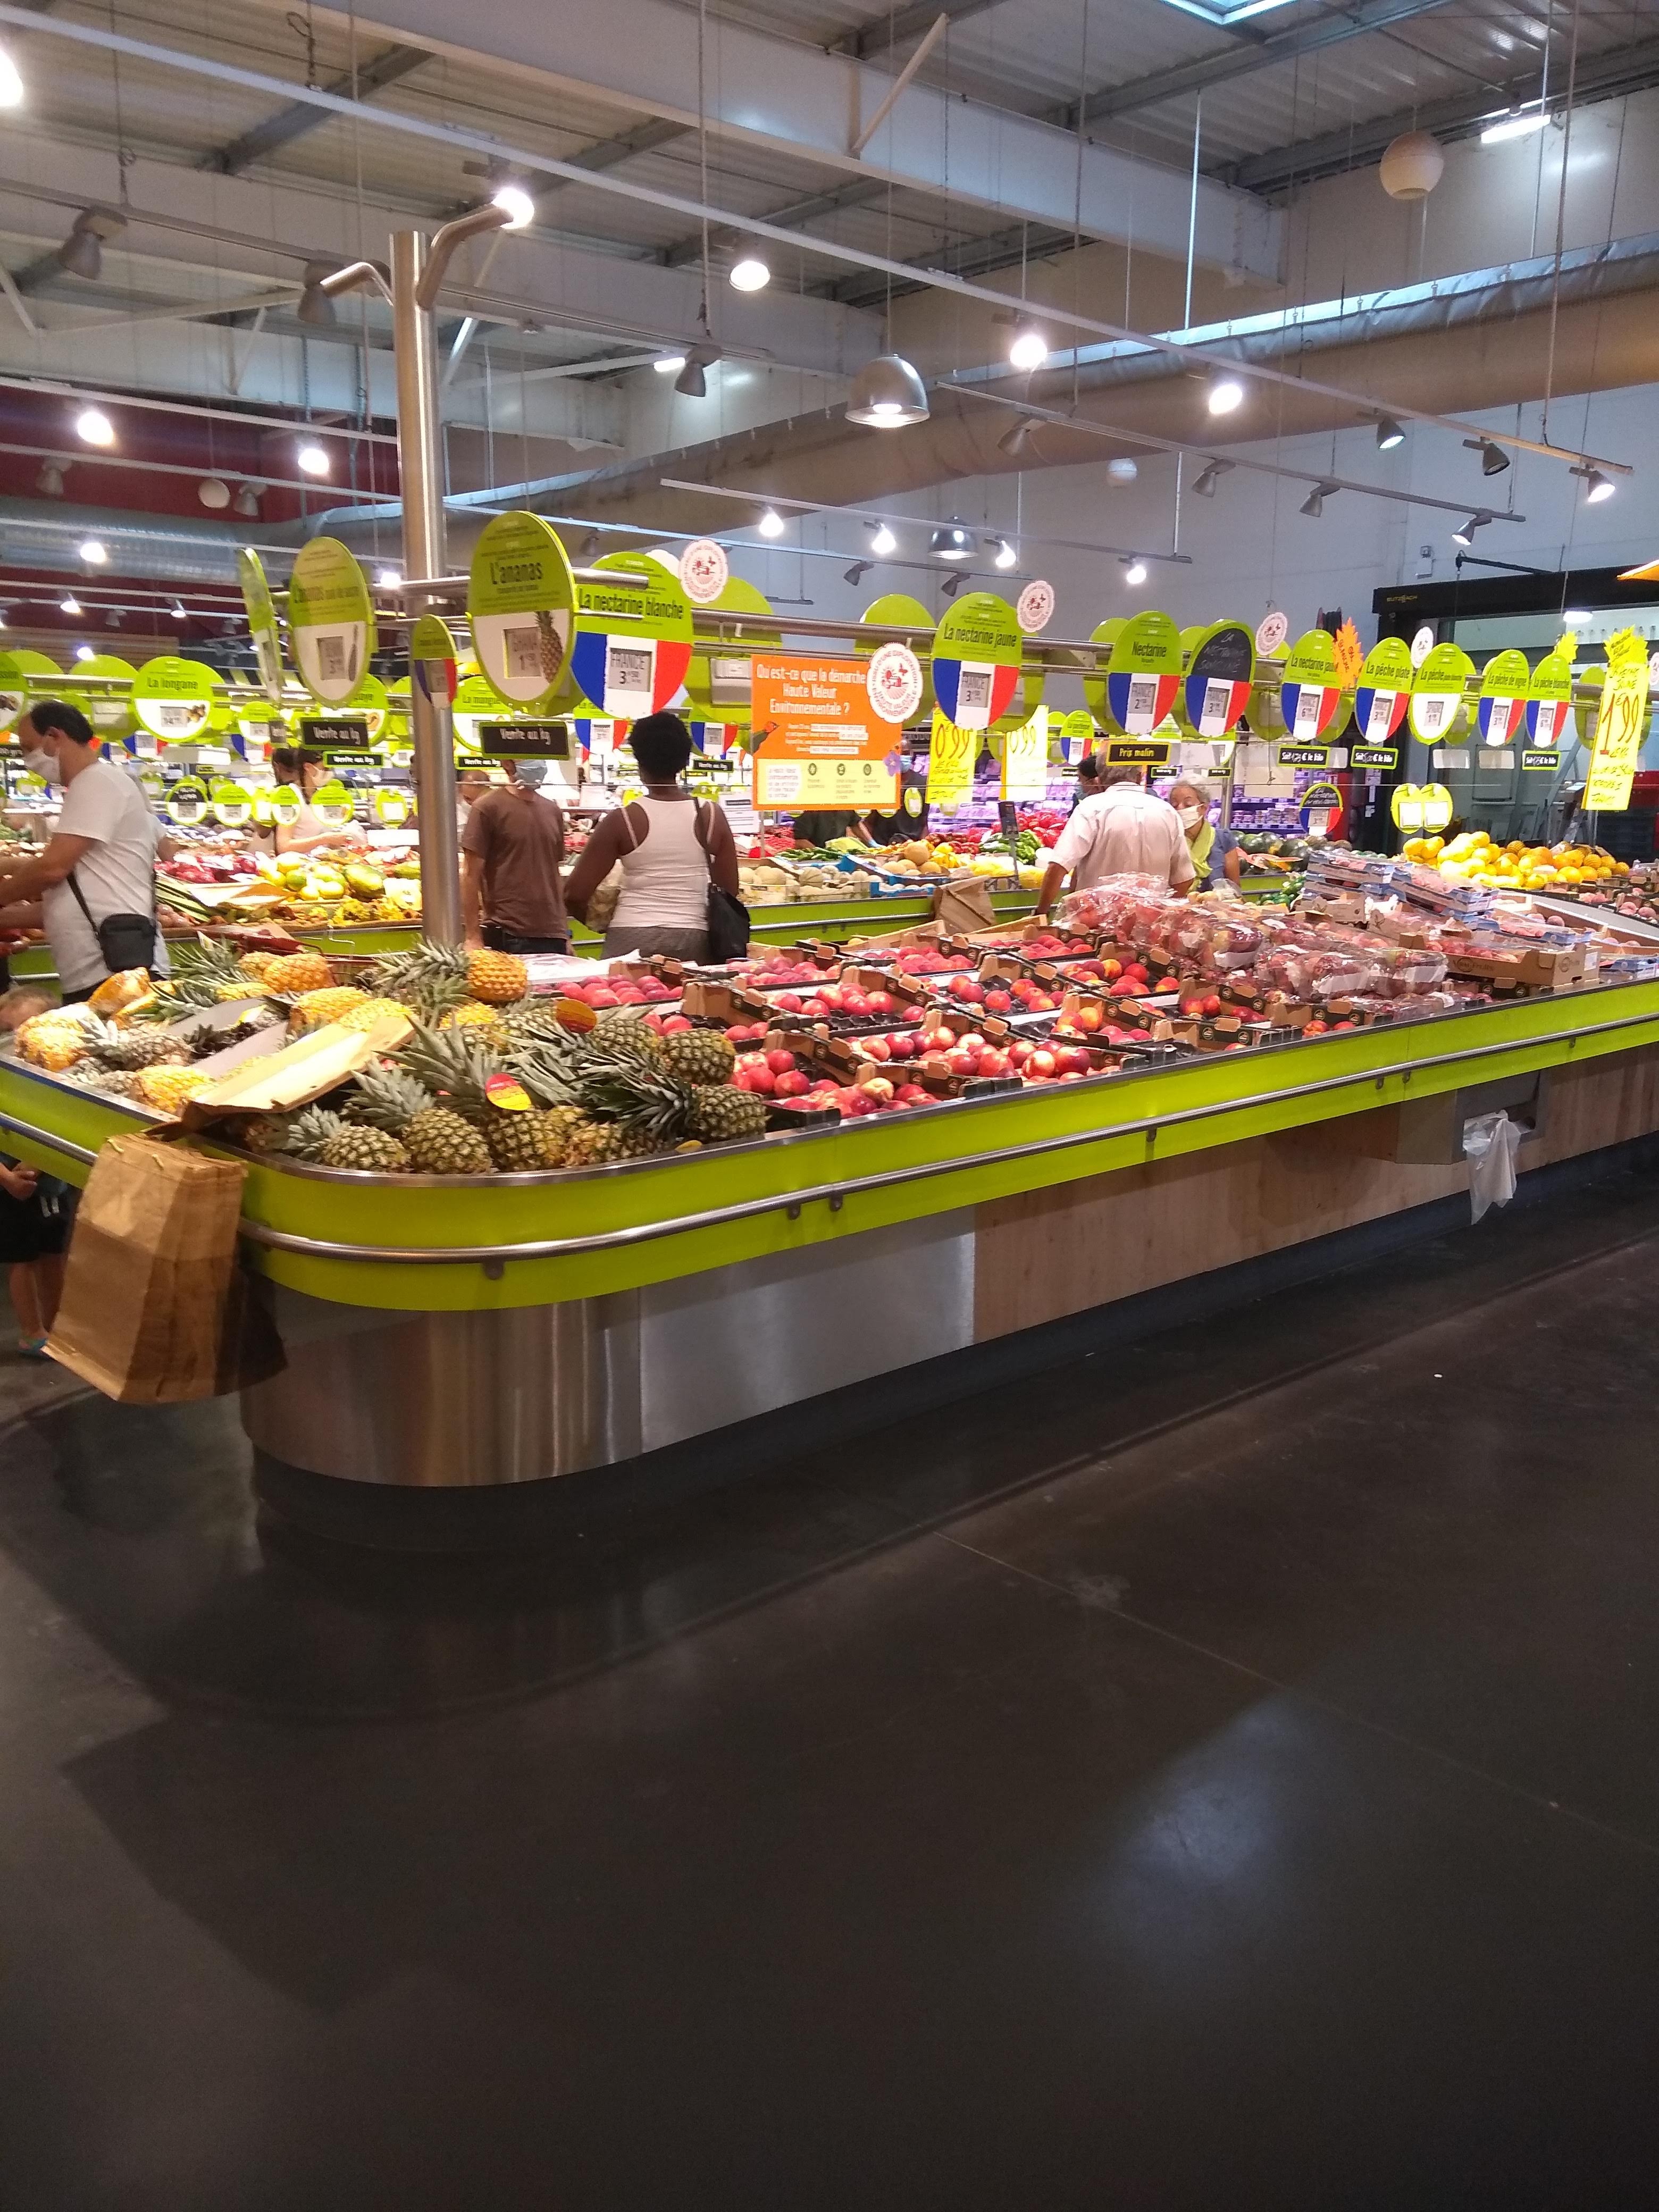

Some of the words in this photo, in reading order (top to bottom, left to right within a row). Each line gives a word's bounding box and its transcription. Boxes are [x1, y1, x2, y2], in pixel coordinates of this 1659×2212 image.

[490, 562, 543, 584] L'ananas
[579, 588, 591, 609] La
[593, 594, 643, 615] nectarine
[646, 596, 684, 620] blanche
[943, 623, 954, 640] La
[955, 627, 994, 646] nectarine
[994, 630, 1017, 648] jaune
[1132, 641, 1167, 658] Nectarine
[1291, 655, 1297, 667] La
[1298, 657, 1323, 671] nectarine
[1366, 661, 1373, 674] La
[1395, 665, 1410, 679] plate
[147, 677, 158, 688] La
[801, 669, 818, 683] que
[819, 667, 827, 682] la
[828, 668, 866, 684] démarche
[1420, 668, 1427, 680] La
[1489, 673, 1495, 684] La
[463, 694, 472, 703] La
[783, 683, 810, 698] Haute
[811, 684, 837, 699] Valeur
[769, 698, 842, 715] Environnementale
[843, 702, 850, 715] ?
[313, 726, 339, 739] Vente
[339, 730, 350, 740] au
[349, 726, 361, 745] kg
[500, 728, 525, 740] Vente
[527, 731, 539, 740] au
[539, 727, 551, 745] kg
[1134, 748, 1155, 757] malin
[1308, 752, 1313, 761] le
